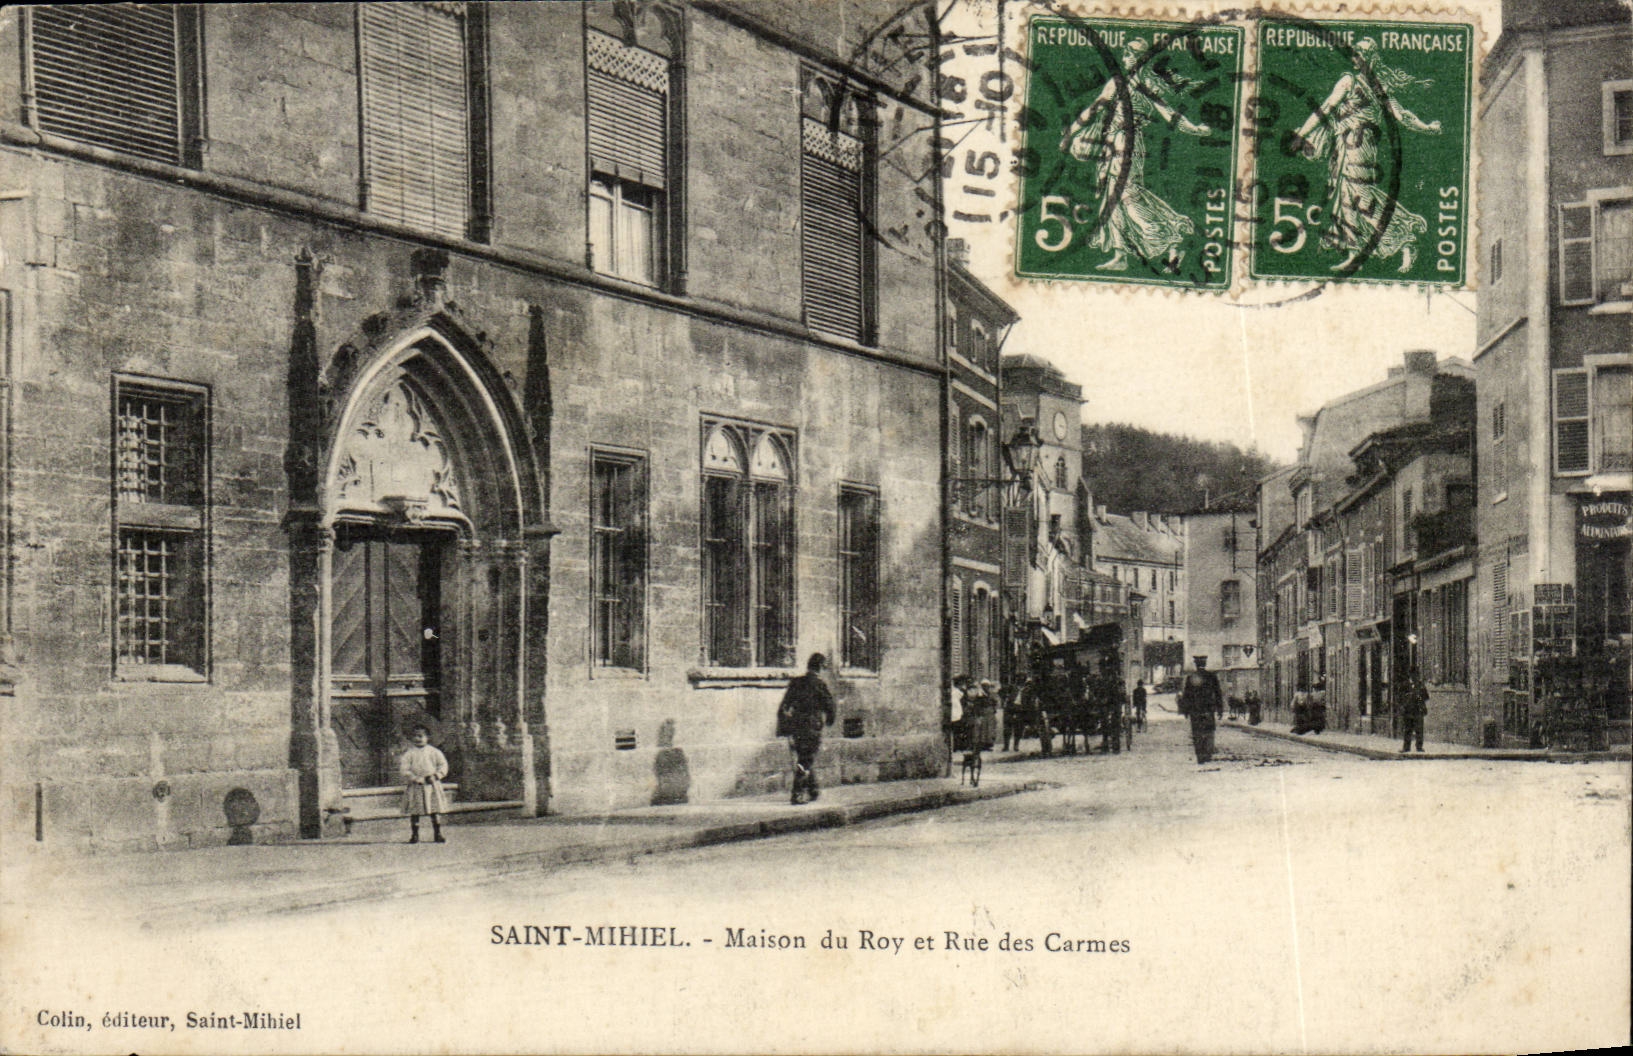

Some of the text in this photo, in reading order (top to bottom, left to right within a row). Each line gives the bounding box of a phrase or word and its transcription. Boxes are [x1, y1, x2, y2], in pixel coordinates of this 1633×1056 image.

[1037, 26, 1126, 47] REPUBLQUE
[1381, 31, 1463, 53] FRANÇAISE
[1203, 188, 1226, 272] POSTES
[1437, 185, 1460, 272] POSTES
